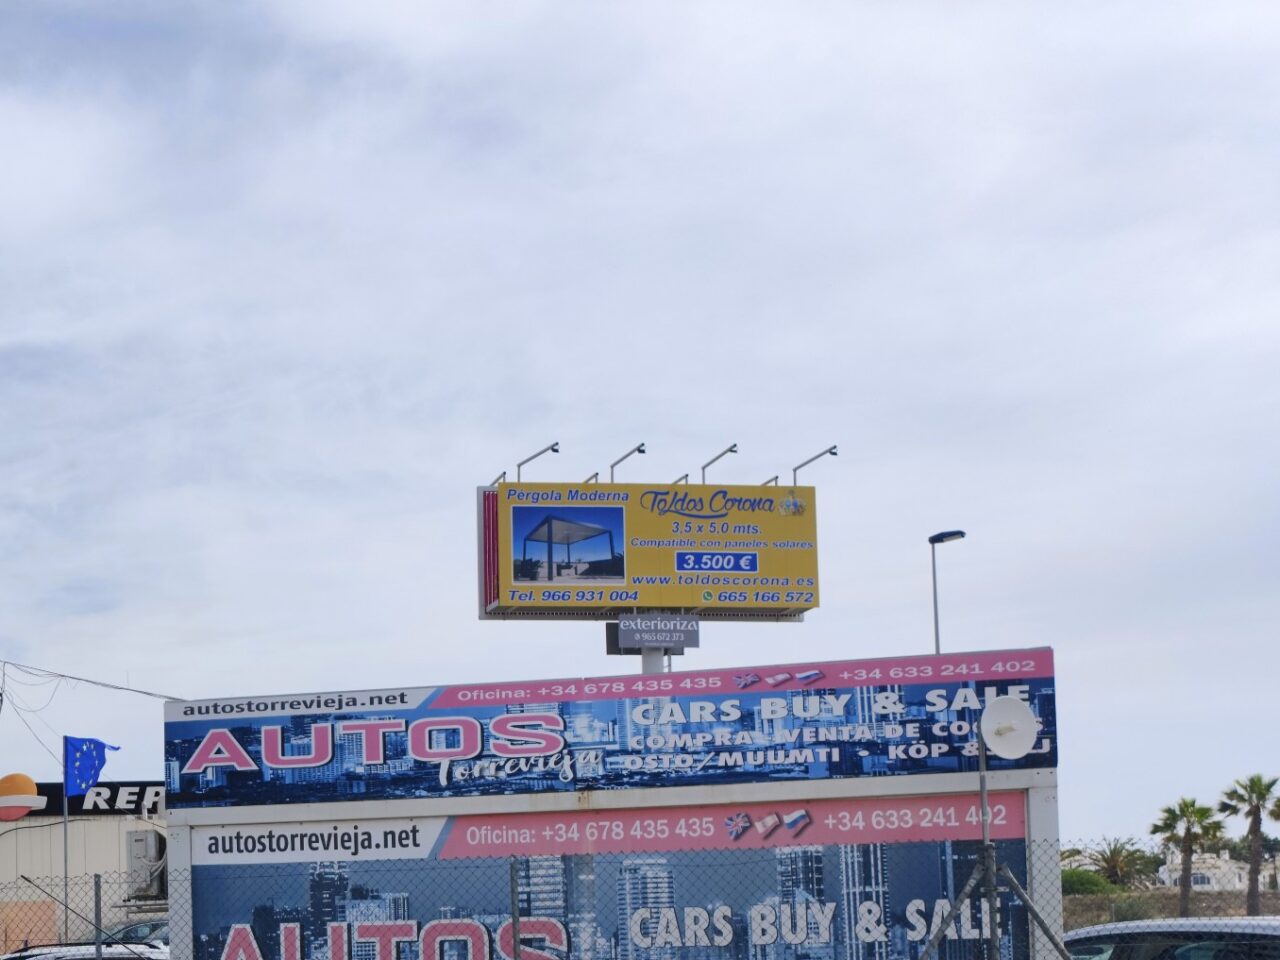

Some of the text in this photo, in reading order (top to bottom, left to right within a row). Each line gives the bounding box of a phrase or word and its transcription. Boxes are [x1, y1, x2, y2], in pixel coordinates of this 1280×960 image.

[568, 489, 629, 501] Moderna
[640, 490, 775, 518] Toldos Corona
[697, 525, 704, 534] x
[631, 537, 813, 549] Compatible con paneles solares
[683, 554, 752, 570] 3.500 €
[632, 575, 815, 586] www.toldoscorona.es
[508, 590, 639, 601] Tel. 966 931 004
[718, 592, 814, 603] 665 166 572
[620, 618, 698, 630] exterioriza
[457, 660, 1035, 701] Oficina: +34 678 435 435 +34 633 241 402
[183, 691, 408, 717] autostorrevieja.net
[632, 699, 741, 725] CARS
[761, 694, 851, 719] BUY
[872, 690, 905, 714] &
[180, 713, 566, 775] AUTOS
[629, 730, 753, 750] COMPRA
[781, 724, 873, 744] VENTA
[886, 722, 920, 739] DE
[887, 740, 949, 760] KÖP
[432, 749, 606, 787] Torrevieja
[466, 804, 1007, 846] Oficina: +34 678 435 435 +34 633 241 402
[207, 824, 420, 855] autostorrevieja.net
[630, 905, 733, 948] CARS
[750, 901, 837, 945] BUY
[856, 900, 889, 943] &
